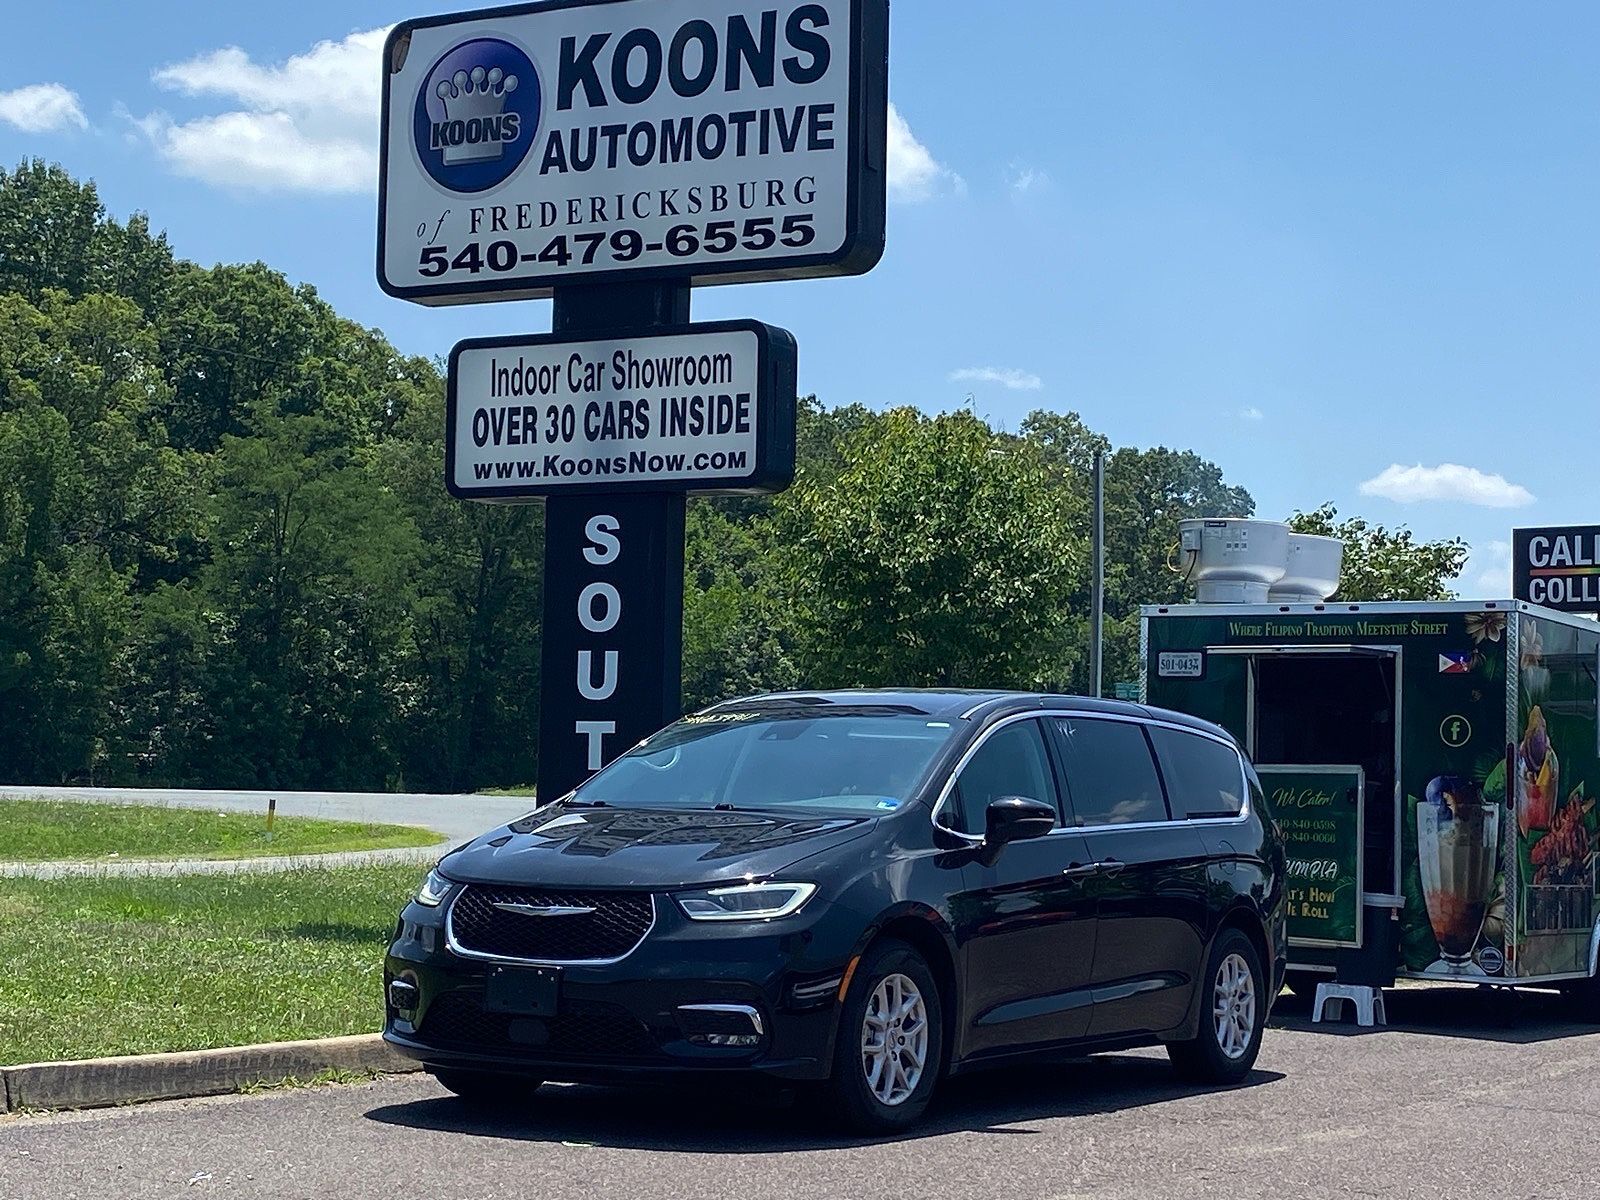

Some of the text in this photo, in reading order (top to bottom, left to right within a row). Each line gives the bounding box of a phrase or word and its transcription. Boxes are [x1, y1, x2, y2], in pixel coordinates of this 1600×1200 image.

[556, 4, 832, 111] KOONS
[431, 114, 520, 148] KOONS
[539, 103, 836, 175] AUTOMOTIVE
[416, 176, 818, 245] of FREDERICKSBURG
[418, 214, 816, 277] 540-479-6555
[491, 350, 732, 397] Indoor Car Showroom
[472, 393, 751, 447] OVER 30 CARS INSIDE
[1529, 577, 1600, 603] COLL
[1411, 619, 1449, 635] STREET
[1272, 787, 1337, 808] We Cater!
[1286, 859, 1338, 879] UMPIA
[1301, 901, 1329, 919] ROLL
